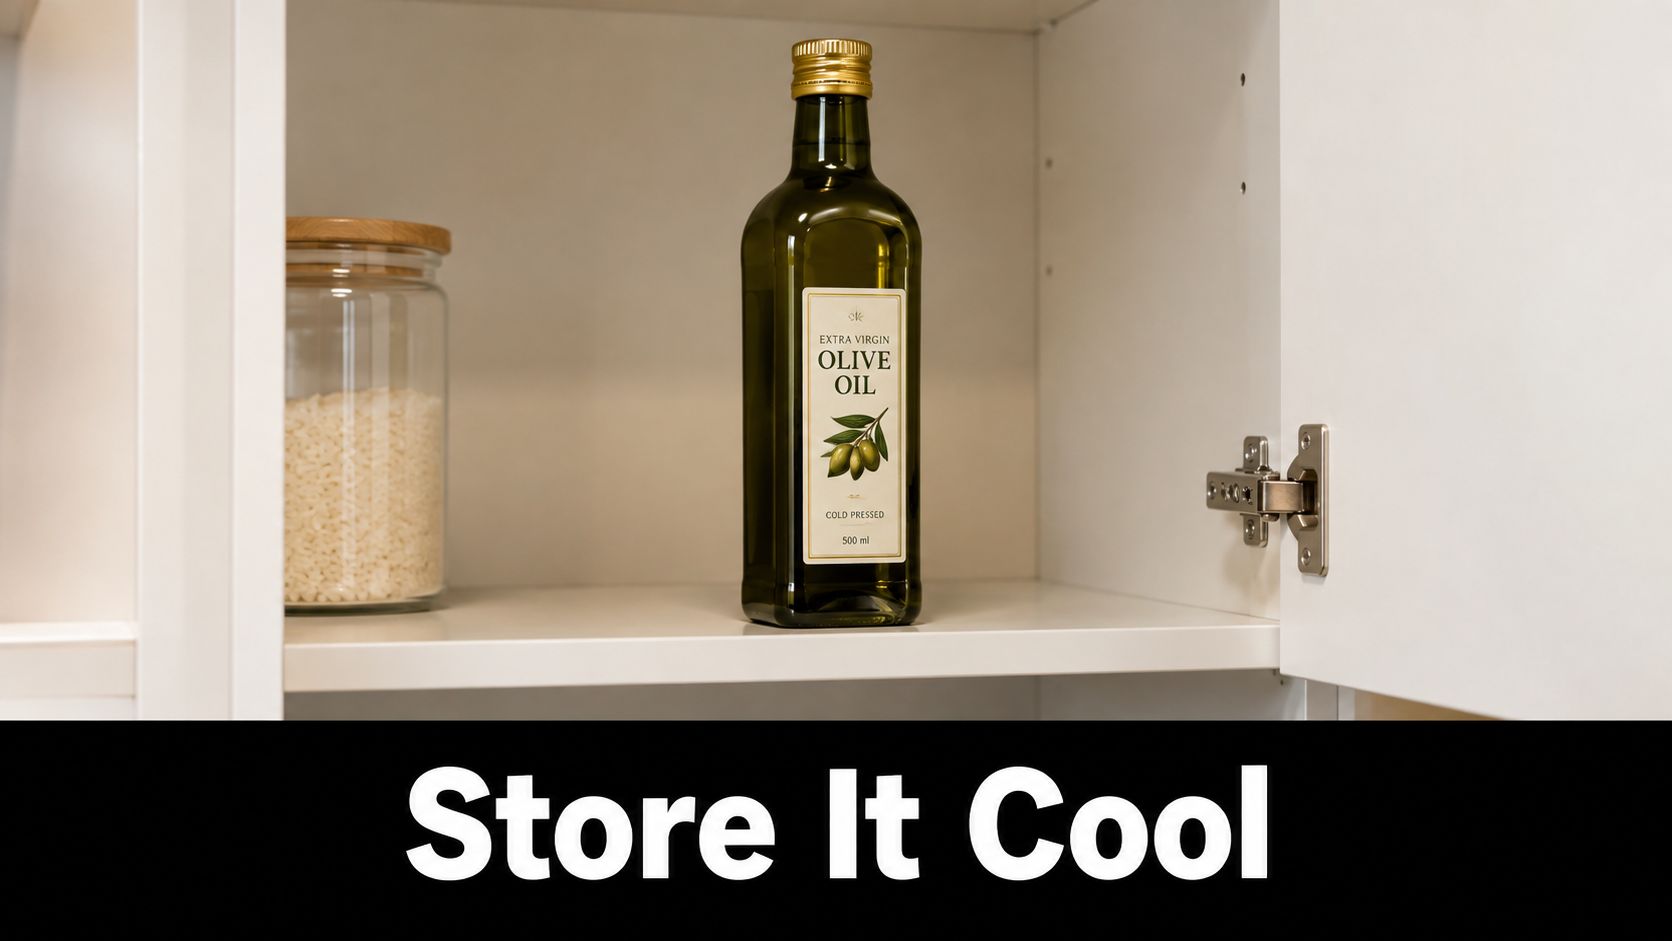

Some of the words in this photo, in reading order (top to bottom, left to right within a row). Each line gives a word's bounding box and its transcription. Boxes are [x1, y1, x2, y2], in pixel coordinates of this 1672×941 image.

[819, 335, 852, 344] EXTRA
[855, 335, 890, 344] VIRGIN
[818, 350, 891, 370] OLIVE
[834, 375, 876, 395] OIL
[825, 511, 848, 519] COLD
[850, 510, 885, 519] PRESSED
[842, 536, 858, 545] 500
[860, 536, 870, 544] ml
